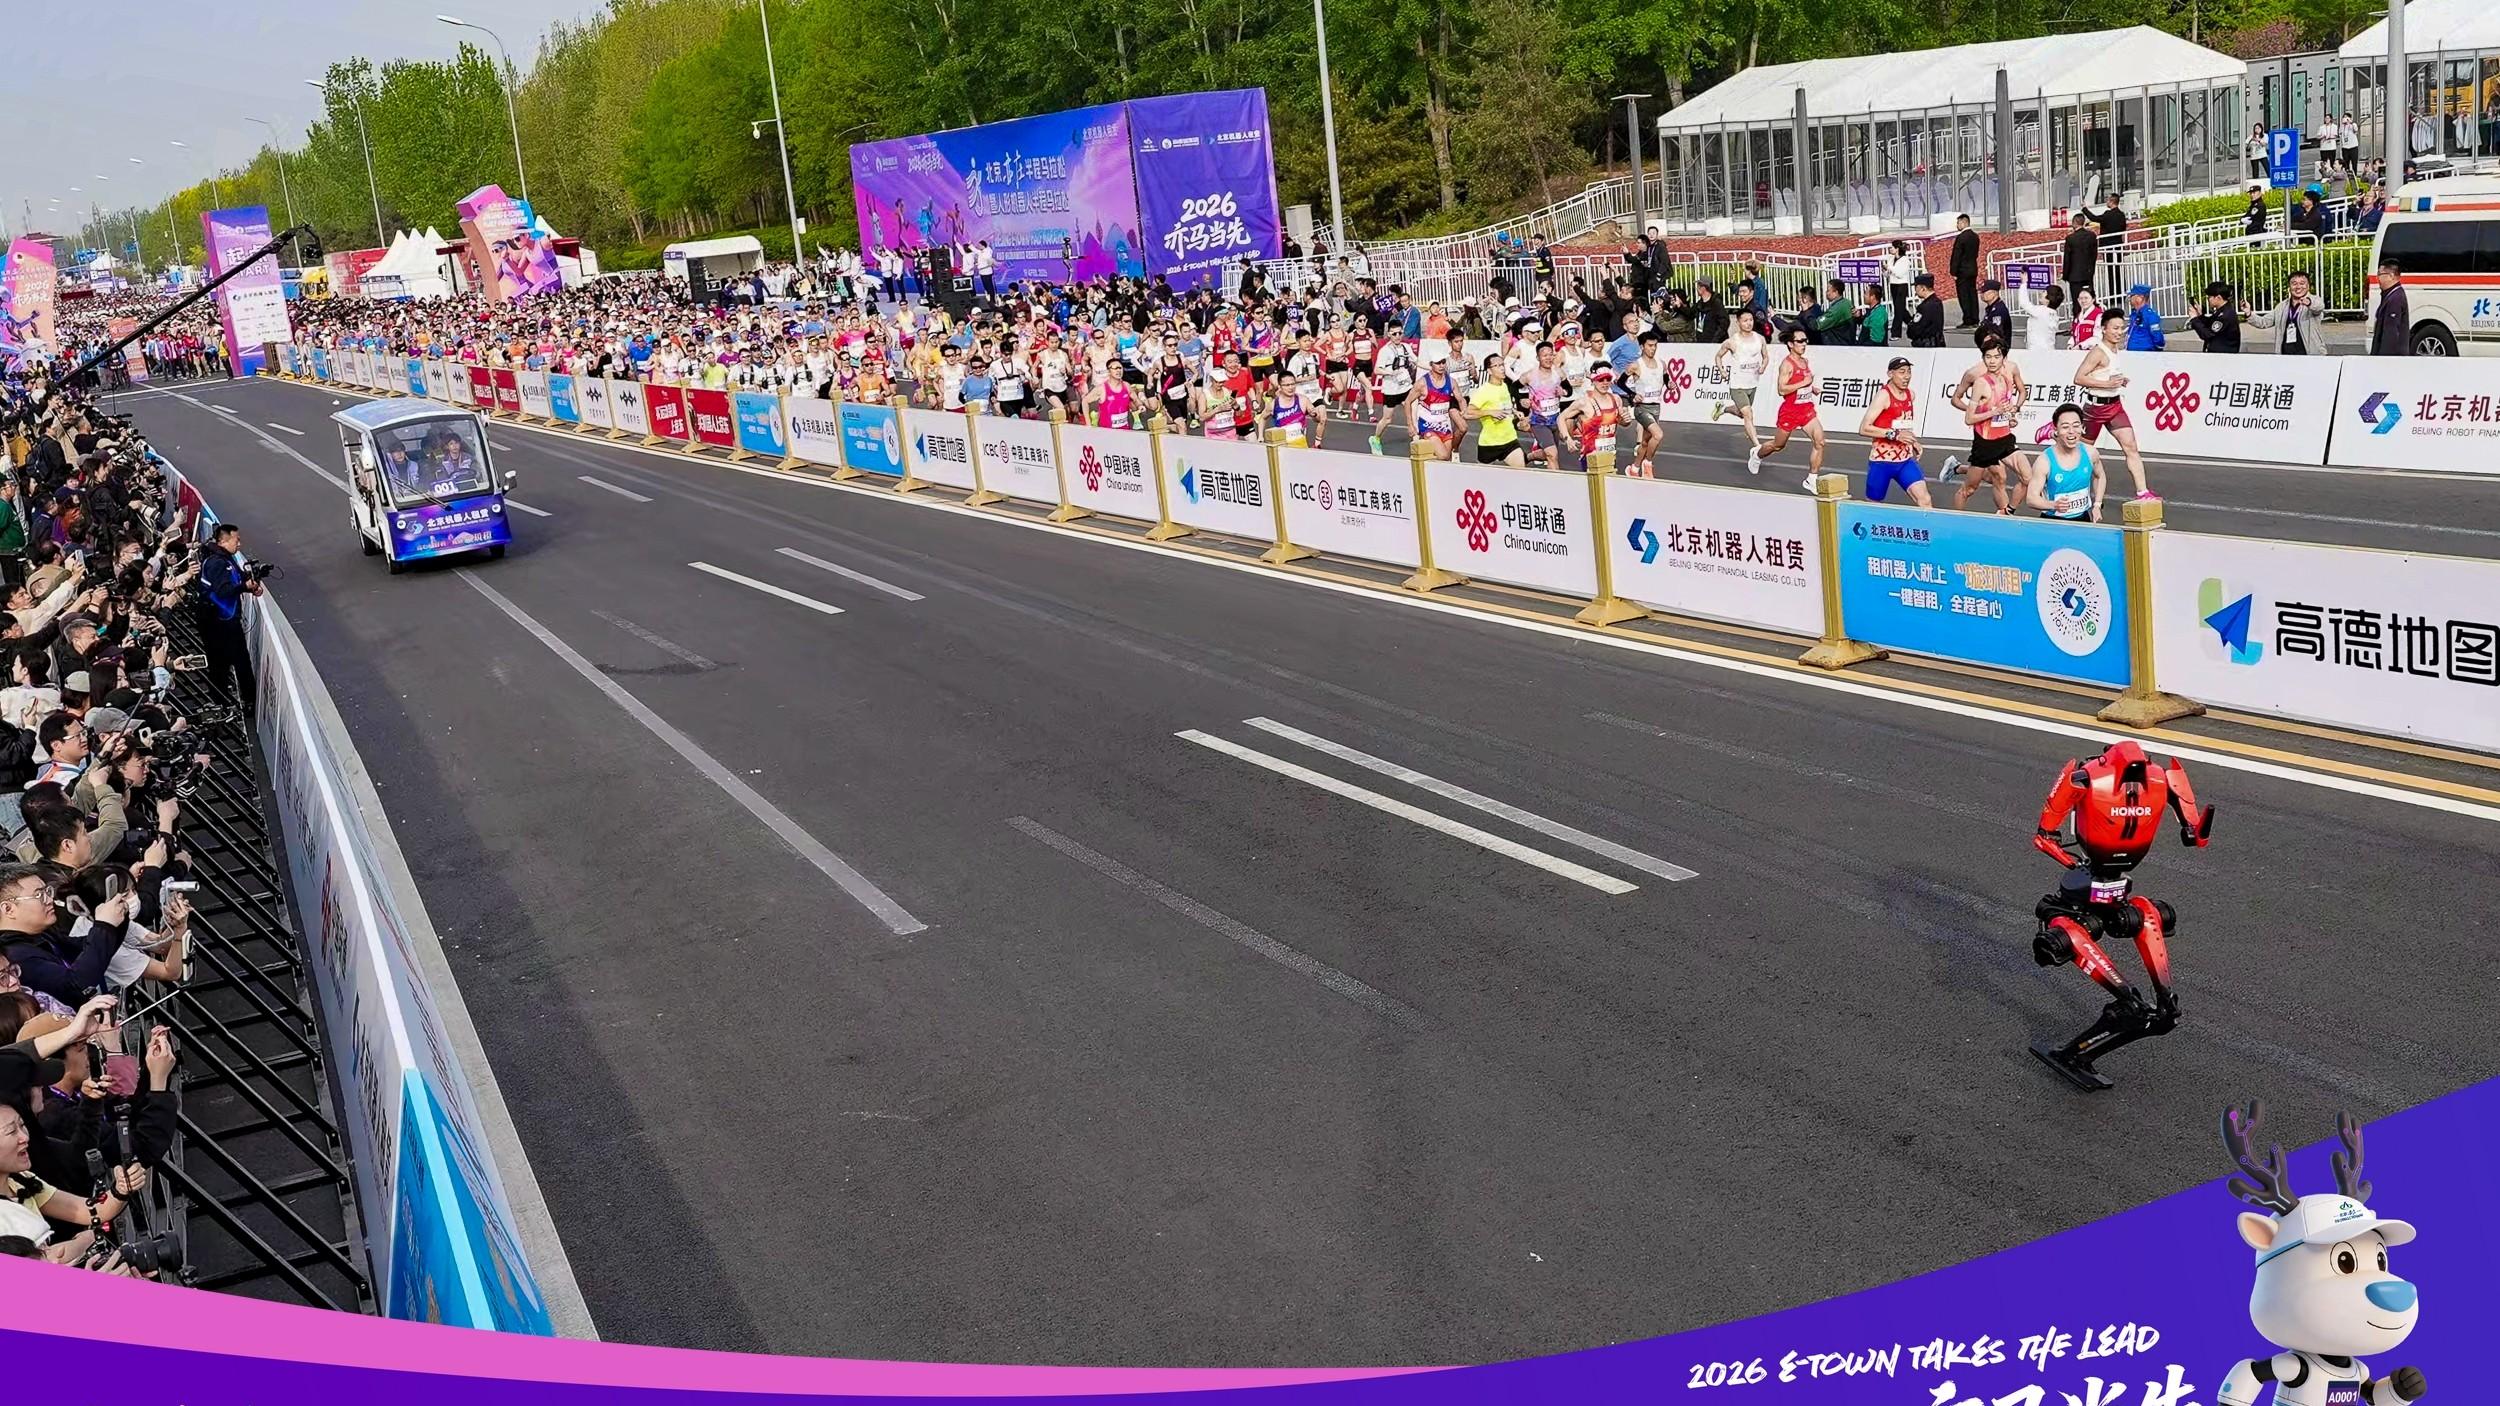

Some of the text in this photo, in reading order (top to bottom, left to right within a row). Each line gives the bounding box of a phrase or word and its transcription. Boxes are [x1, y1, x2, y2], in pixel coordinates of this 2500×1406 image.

[2274, 133, 2291, 166] P
[2274, 171, 2295, 182] 停车场
[1180, 191, 1237, 223] 2026
[1163, 216, 1251, 260] 亦马当先
[1694, 388, 1718, 399] China
[2208, 380, 2296, 412] 中国联通
[2204, 412, 2290, 432] China unicom
[2411, 426, 2443, 436] BEIJING
[2446, 427, 2475, 437] ROBOT
[926, 434, 967, 464] 高德地图
[983, 443, 999, 458] ICBC
[1011, 445, 1049, 464] 中国工商银行
[1103, 453, 1141, 477] 中国联通
[434, 481, 455, 494] 001
[1106, 477, 1143, 493] China unicom
[1199, 469, 1263, 508] 高德地图
[1289, 482, 1316, 502] ICBC
[1337, 486, 1403, 514] 中国工商银行
[426, 508, 489, 528] 北京机器人租赁
[1501, 501, 1566, 535] 中国联通
[1503, 534, 1569, 556] China unicom
[1870, 524, 1930, 542] 北京机器人租赁
[1667, 523, 1805, 572] 北京机器人租赁
[1668, 558, 1692, 570] BEIJING
[1693, 561, 1715, 573] ROBOT
[1717, 565, 1749, 579] FINANCIAL
[1751, 571, 1779, 584] LEASING
[1867, 556, 1948, 585] 租机器人就上
[2275, 601, 2500, 687] 高德地图
[2110, 806, 2152, 817] HONOR
[2083, 943, 2112, 973] FLASH
